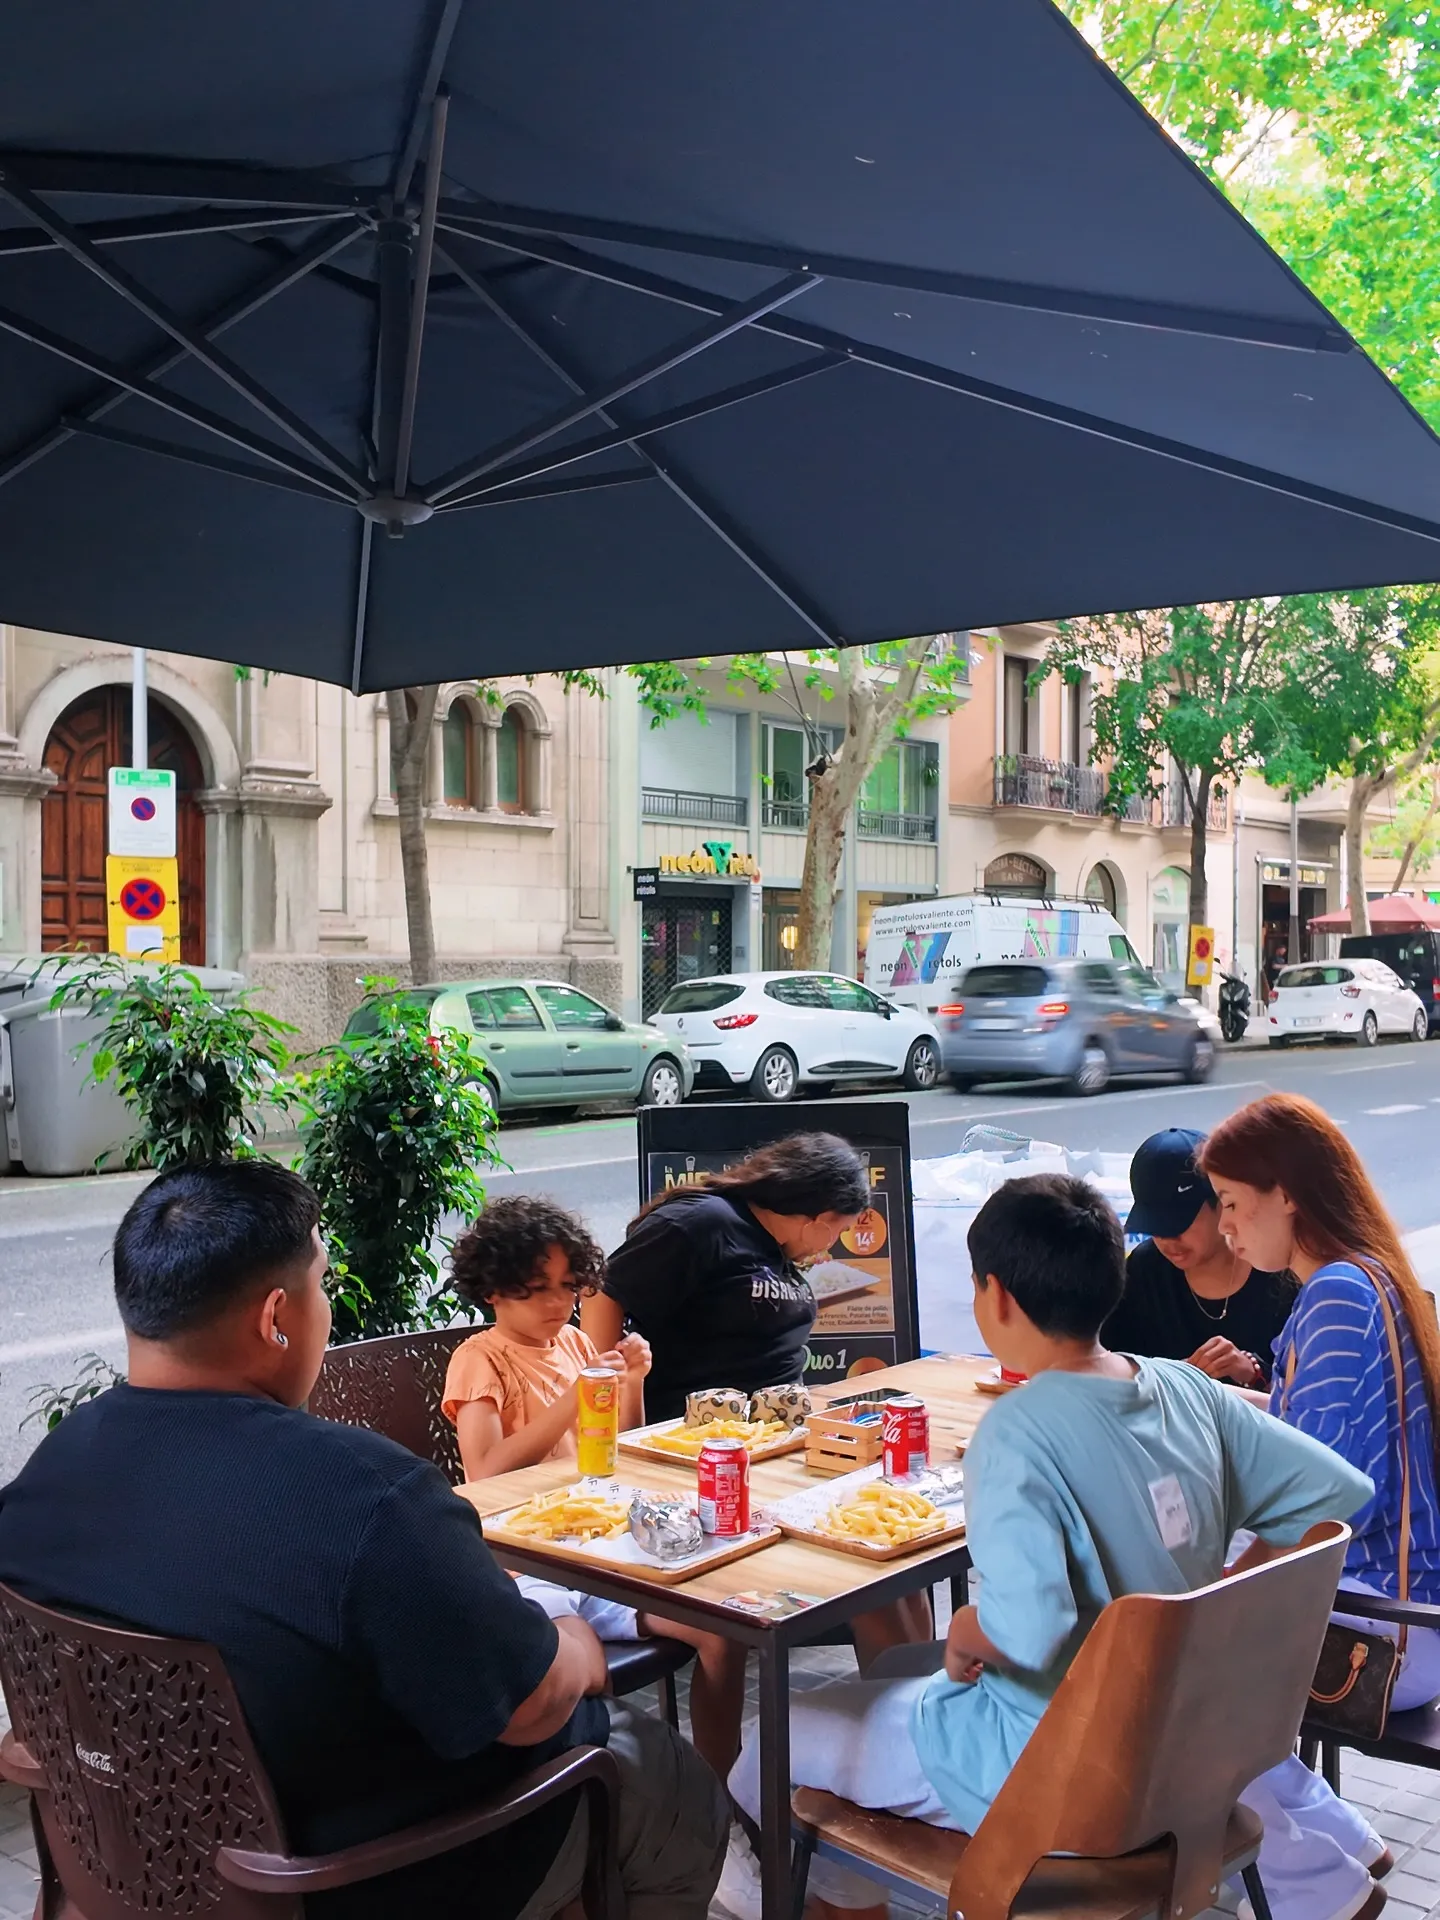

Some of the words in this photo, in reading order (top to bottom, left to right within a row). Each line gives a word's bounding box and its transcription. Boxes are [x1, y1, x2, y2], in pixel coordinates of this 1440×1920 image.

[874, 909, 973, 925] neon@rotulosvaliente.com
[876, 920, 971, 935] www.rotulosvaliente.com
[855, 1231, 875, 1247] 14€
[836, 1348, 847, 1369] 1
